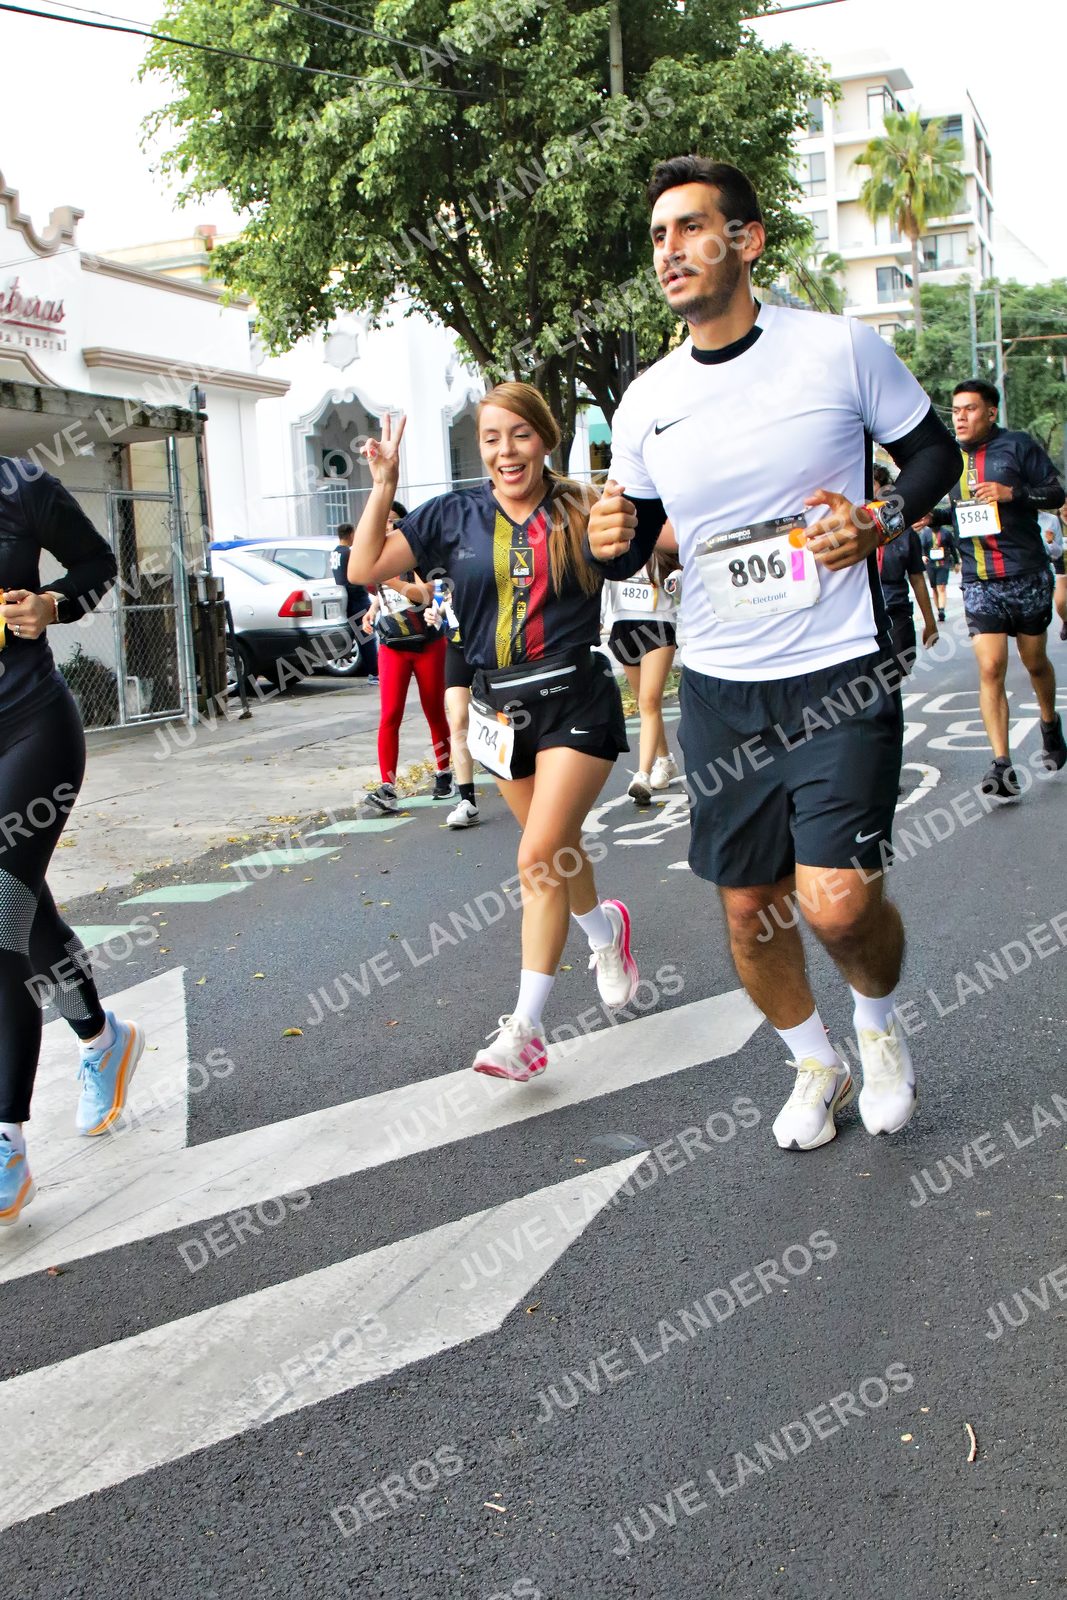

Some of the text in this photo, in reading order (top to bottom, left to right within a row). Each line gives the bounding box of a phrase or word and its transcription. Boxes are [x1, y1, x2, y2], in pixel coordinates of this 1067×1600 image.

[960, 510, 989, 525] 5584
[728, 549, 787, 588] 806
[622, 587, 649, 600] 4820
